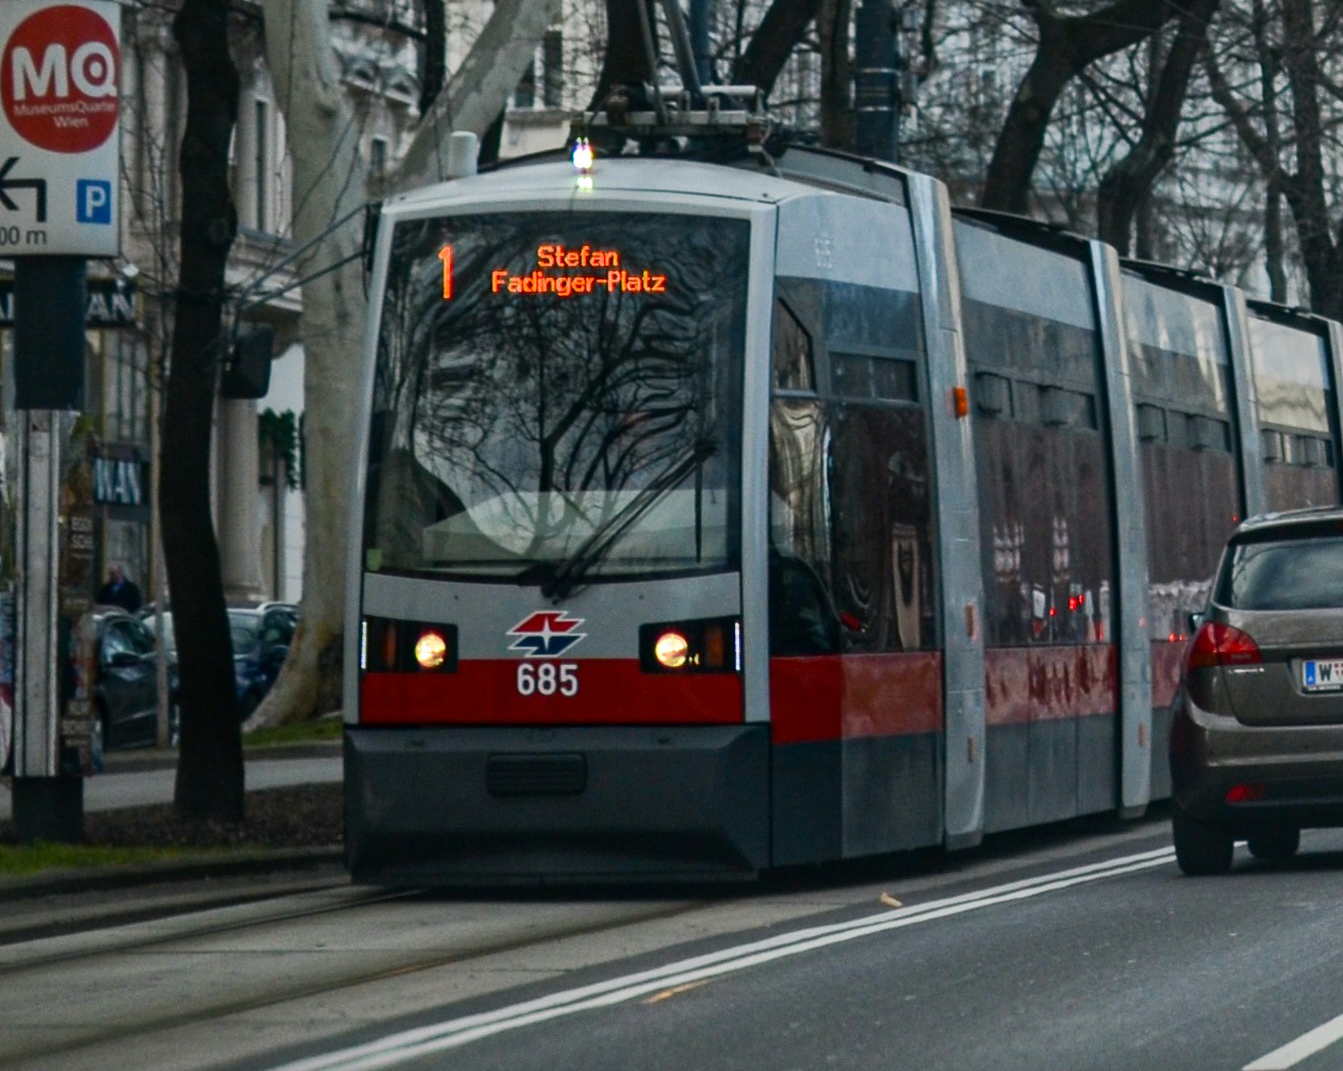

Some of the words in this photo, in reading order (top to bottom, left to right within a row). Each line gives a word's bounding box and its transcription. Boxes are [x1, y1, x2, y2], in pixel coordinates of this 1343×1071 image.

[12, 41, 117, 101] MQ
[53, 116, 89, 128] Wien
[85, 185, 107, 218] P
[27, 230, 47, 245] m
[438, 244, 453, 299] 1
[537, 245, 618, 267] Stefan
[492, 270, 666, 297] Fadinger-Platz
[517, 663, 578, 696] 685
[1319, 664, 1332, 682] W
